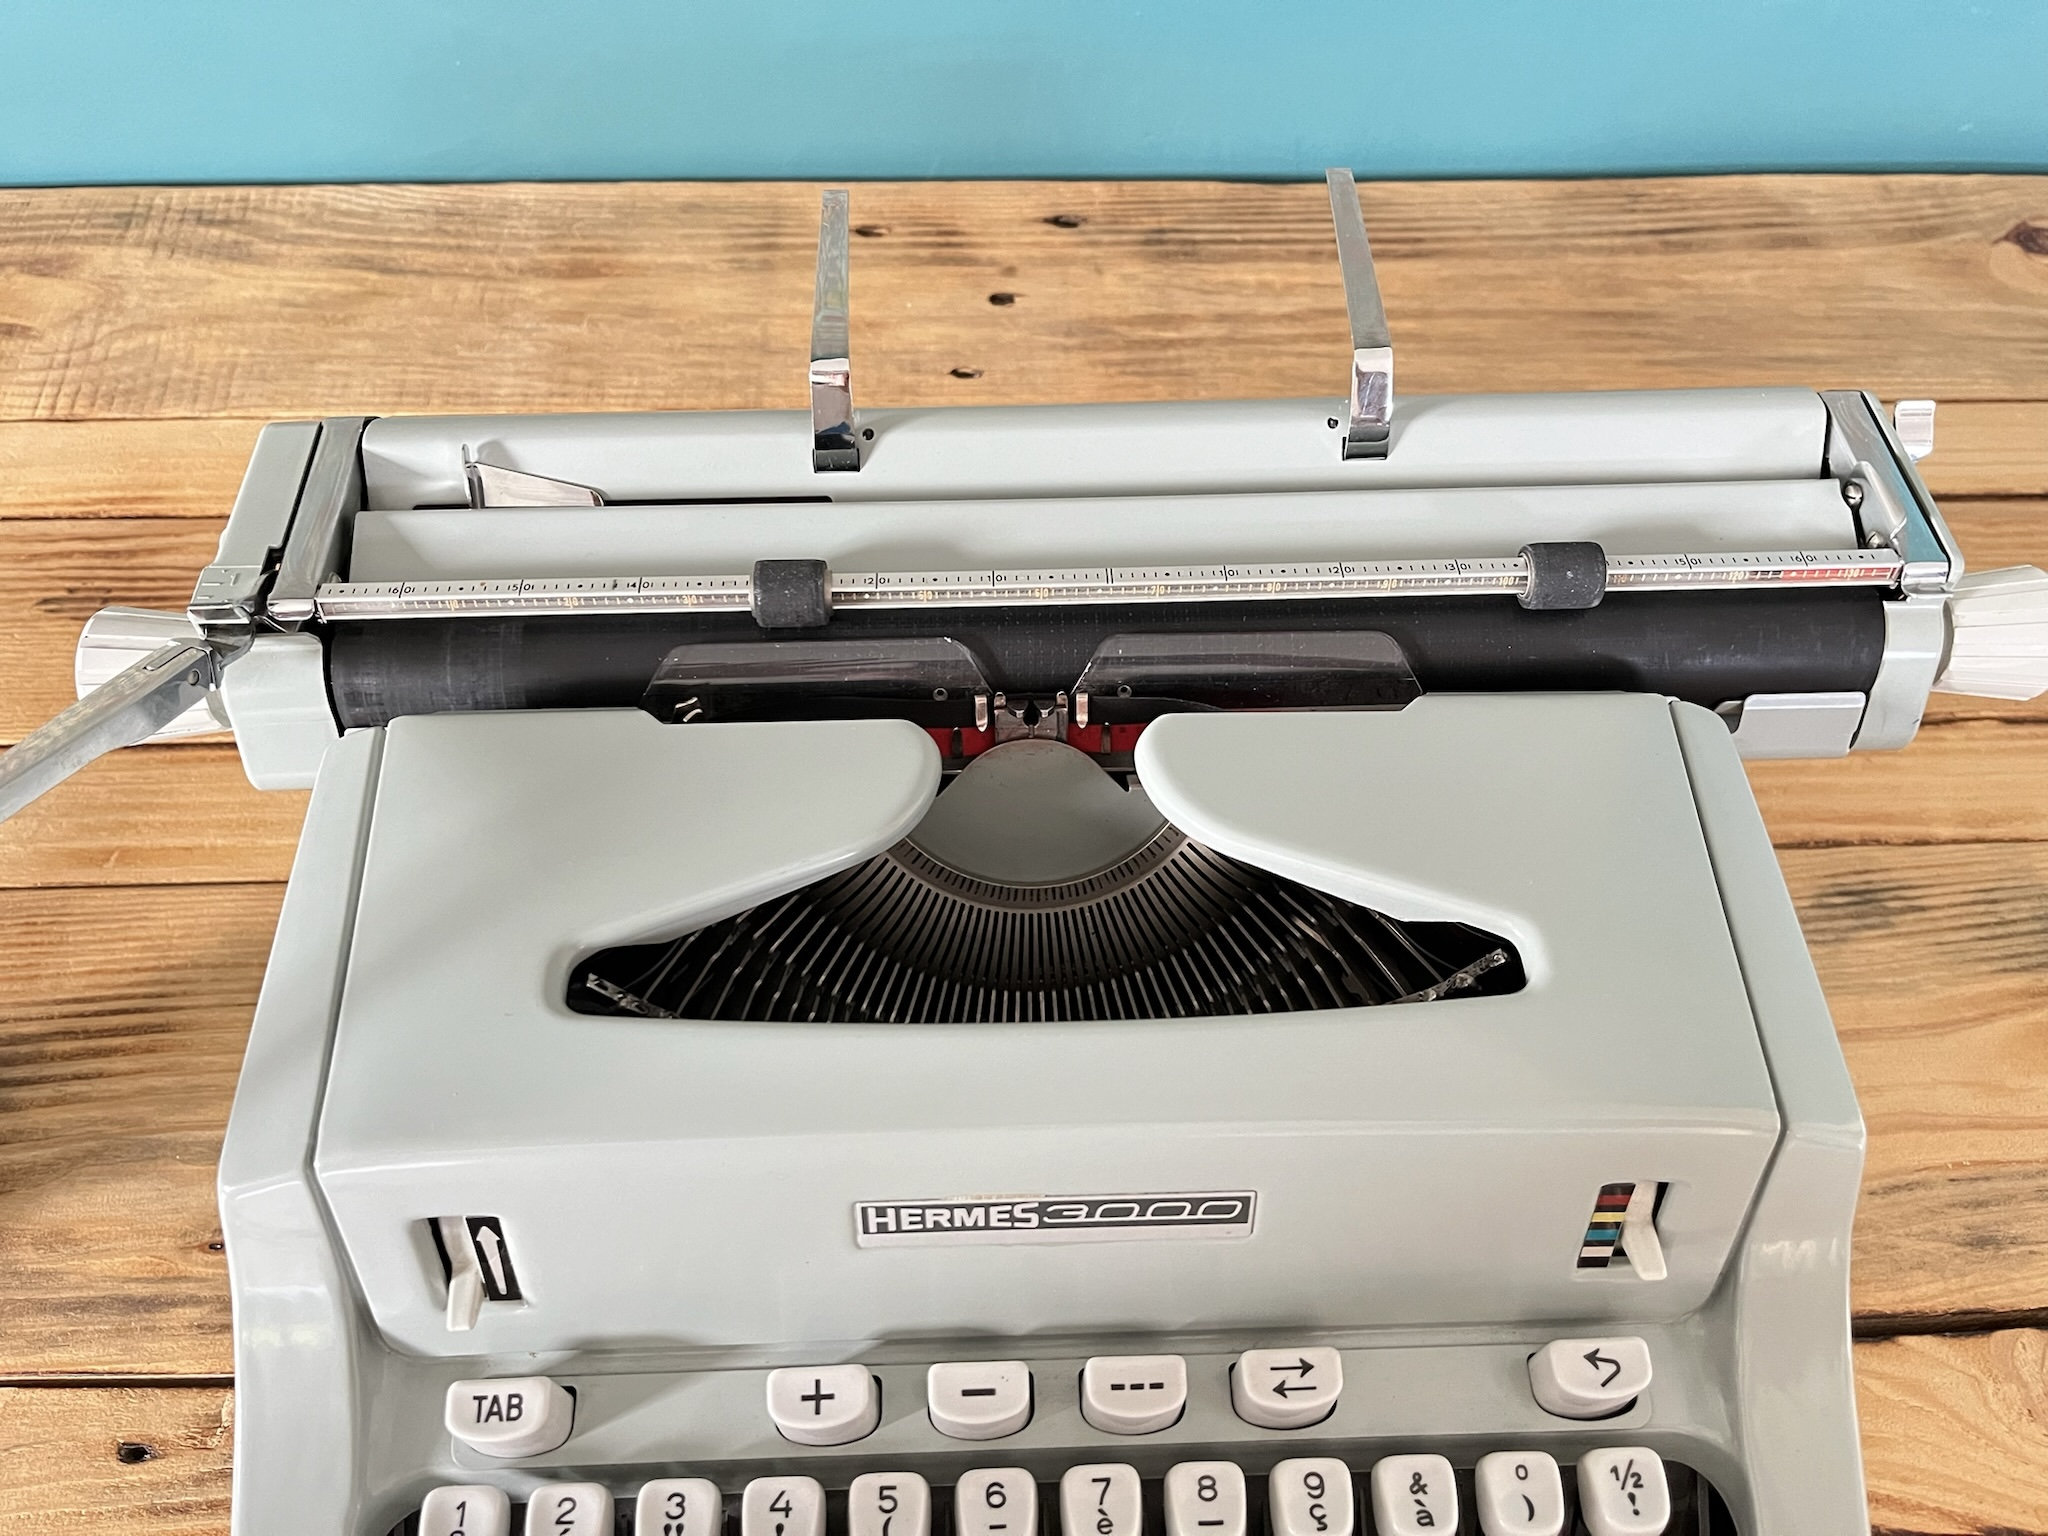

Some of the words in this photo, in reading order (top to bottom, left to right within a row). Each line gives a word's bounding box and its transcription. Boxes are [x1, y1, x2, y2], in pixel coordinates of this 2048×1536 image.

[866, 1202, 1039, 1234] HERMES
[1042, 1199, 1244, 1224] 3000
[472, 1392, 524, 1423] TAB
[985, 1481, 1007, 1509] 6
[1091, 1477, 1112, 1506] 7
[1198, 1475, 1218, 1501] 8
[1303, 1471, 1325, 1499] 9
[1409, 1472, 1428, 1495] &
[555, 1497, 577, 1525] 2
[665, 1492, 686, 1520] 3
[769, 1490, 793, 1518] 4
[878, 1485, 898, 1514] 5
[1413, 1499, 1435, 1528] à
[456, 1501, 467, 1527] 1
